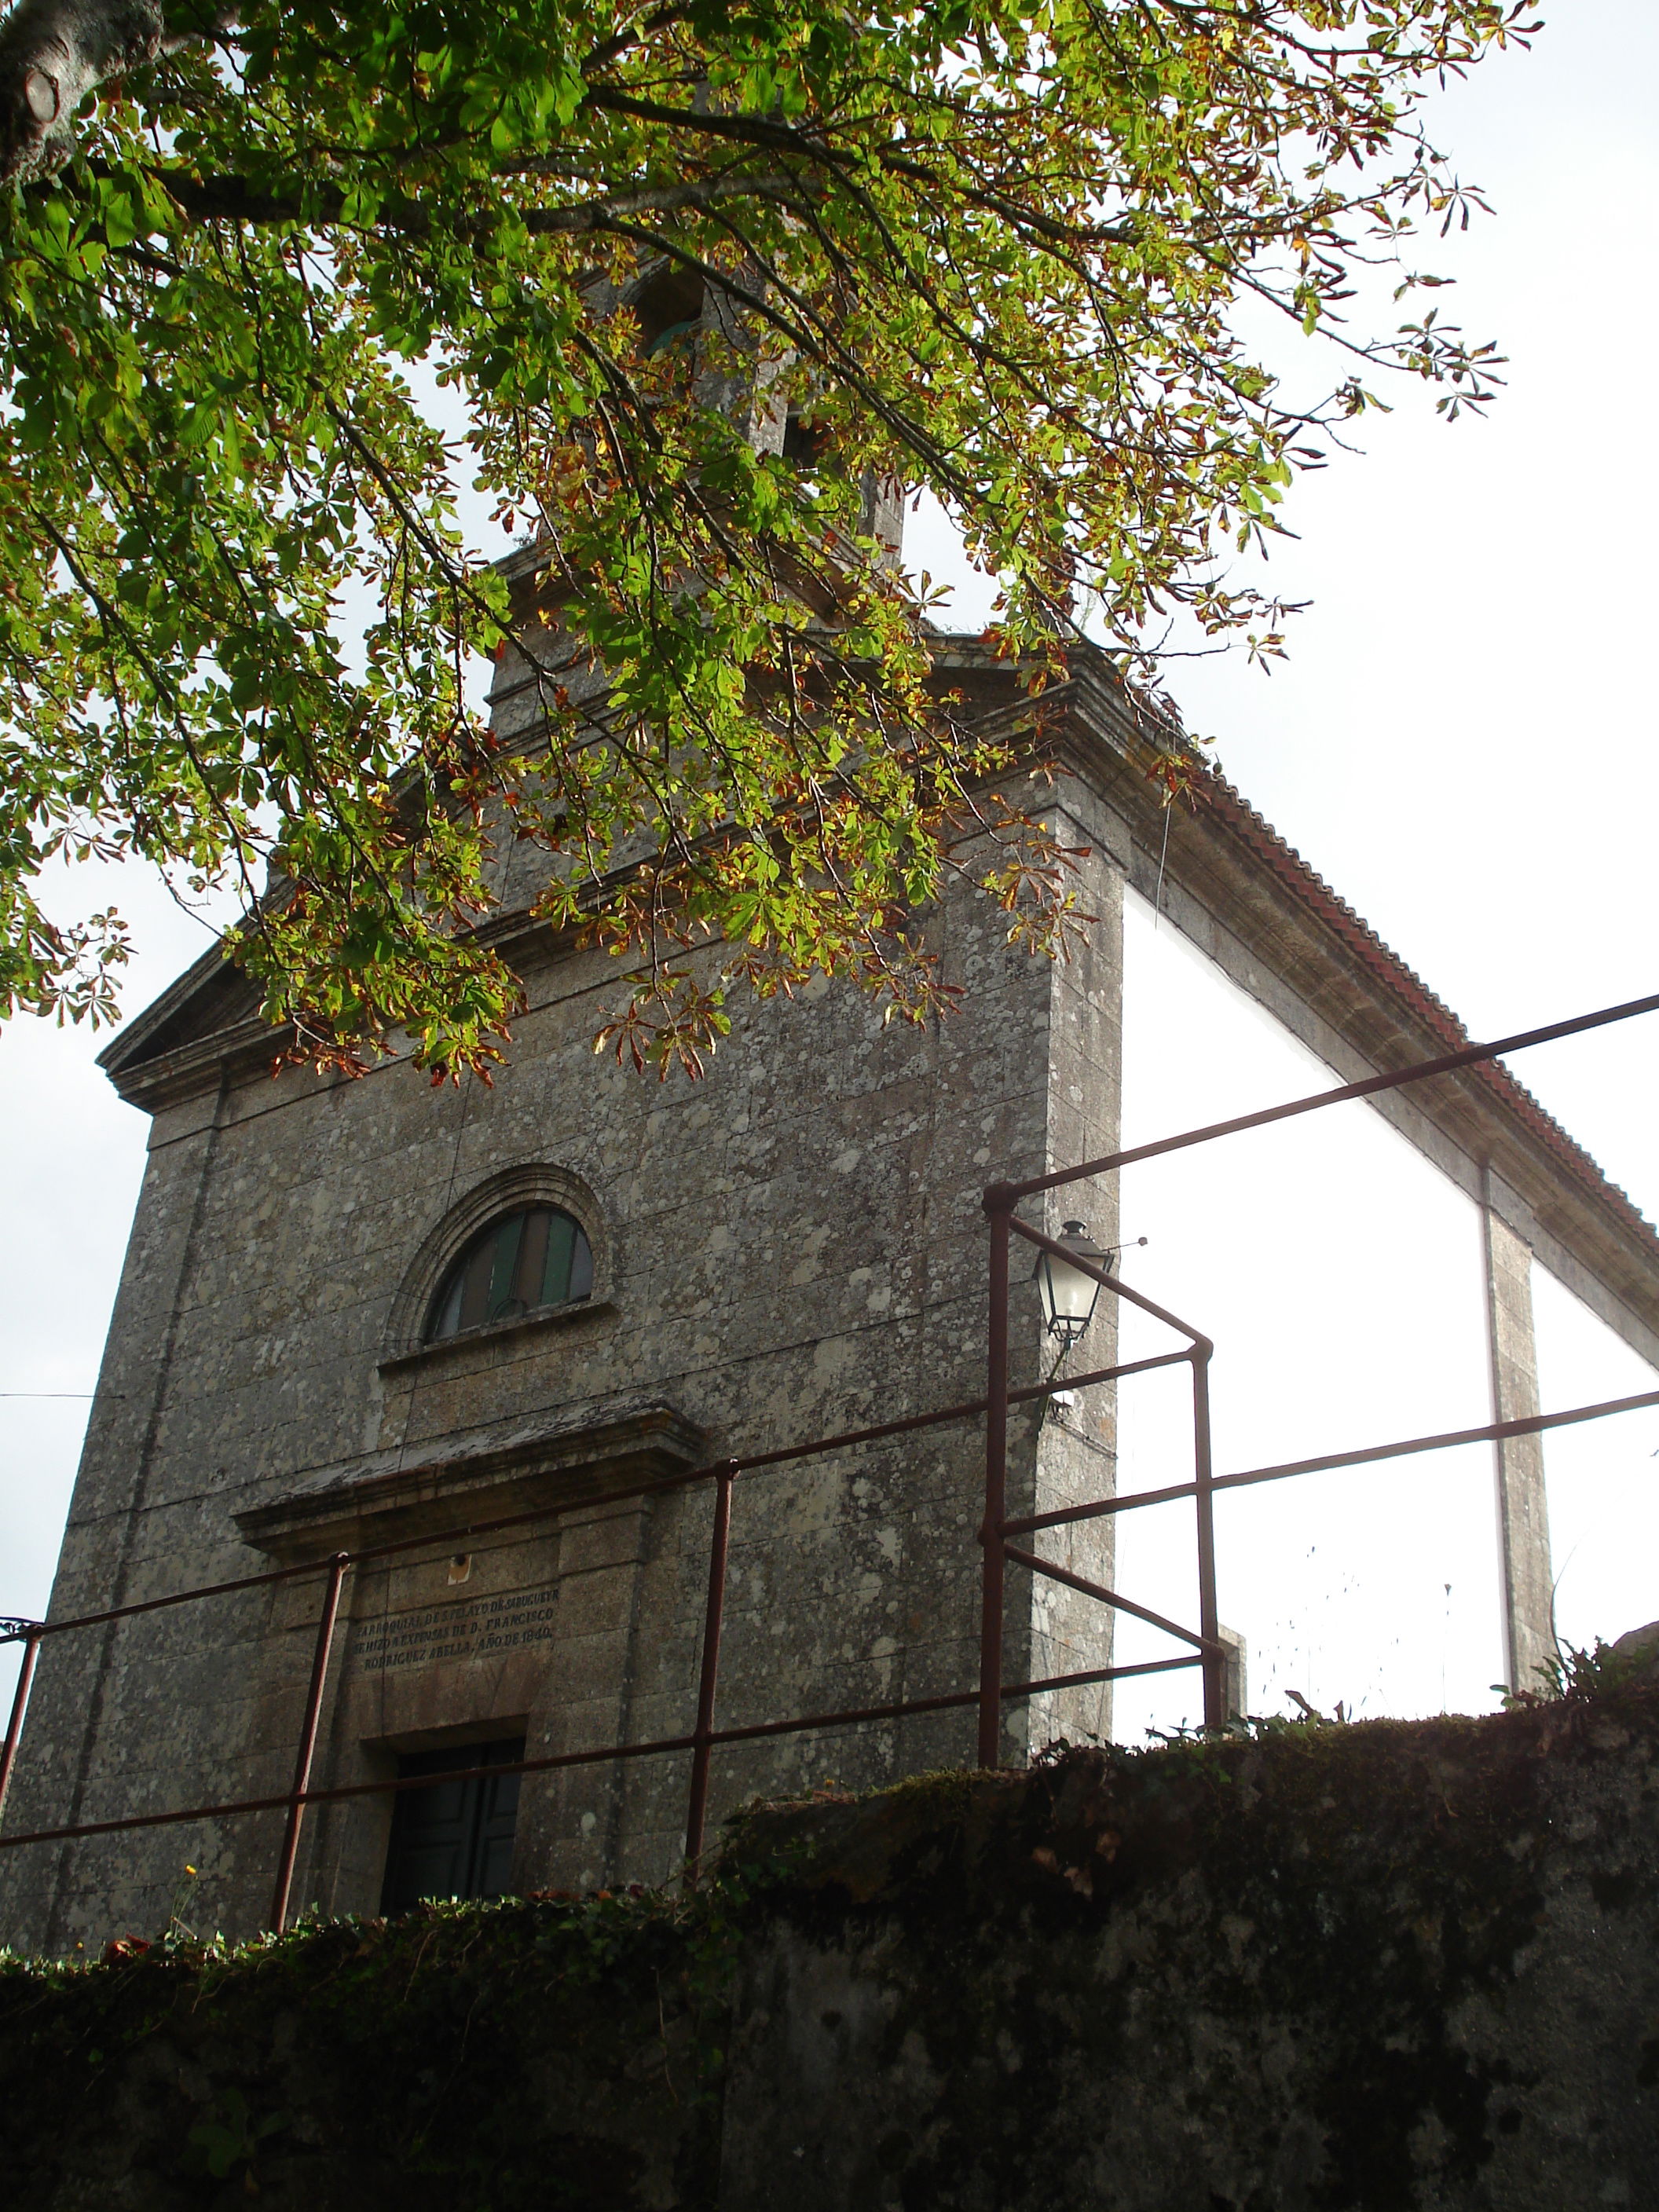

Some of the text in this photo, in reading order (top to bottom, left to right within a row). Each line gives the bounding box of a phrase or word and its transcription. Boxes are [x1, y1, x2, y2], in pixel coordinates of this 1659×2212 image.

[365, 1639, 390, 1653] HIZO
[452, 1624, 465, 1636] DE
[486, 1607, 554, 1630] FRANCISCO
[425, 1612, 439, 1625] DE
[491, 1599, 504, 1612] DE
[364, 1651, 427, 1671] RODRIGUEZ
[478, 1632, 502, 1651] AÑO
[504, 1632, 520, 1646] DE
